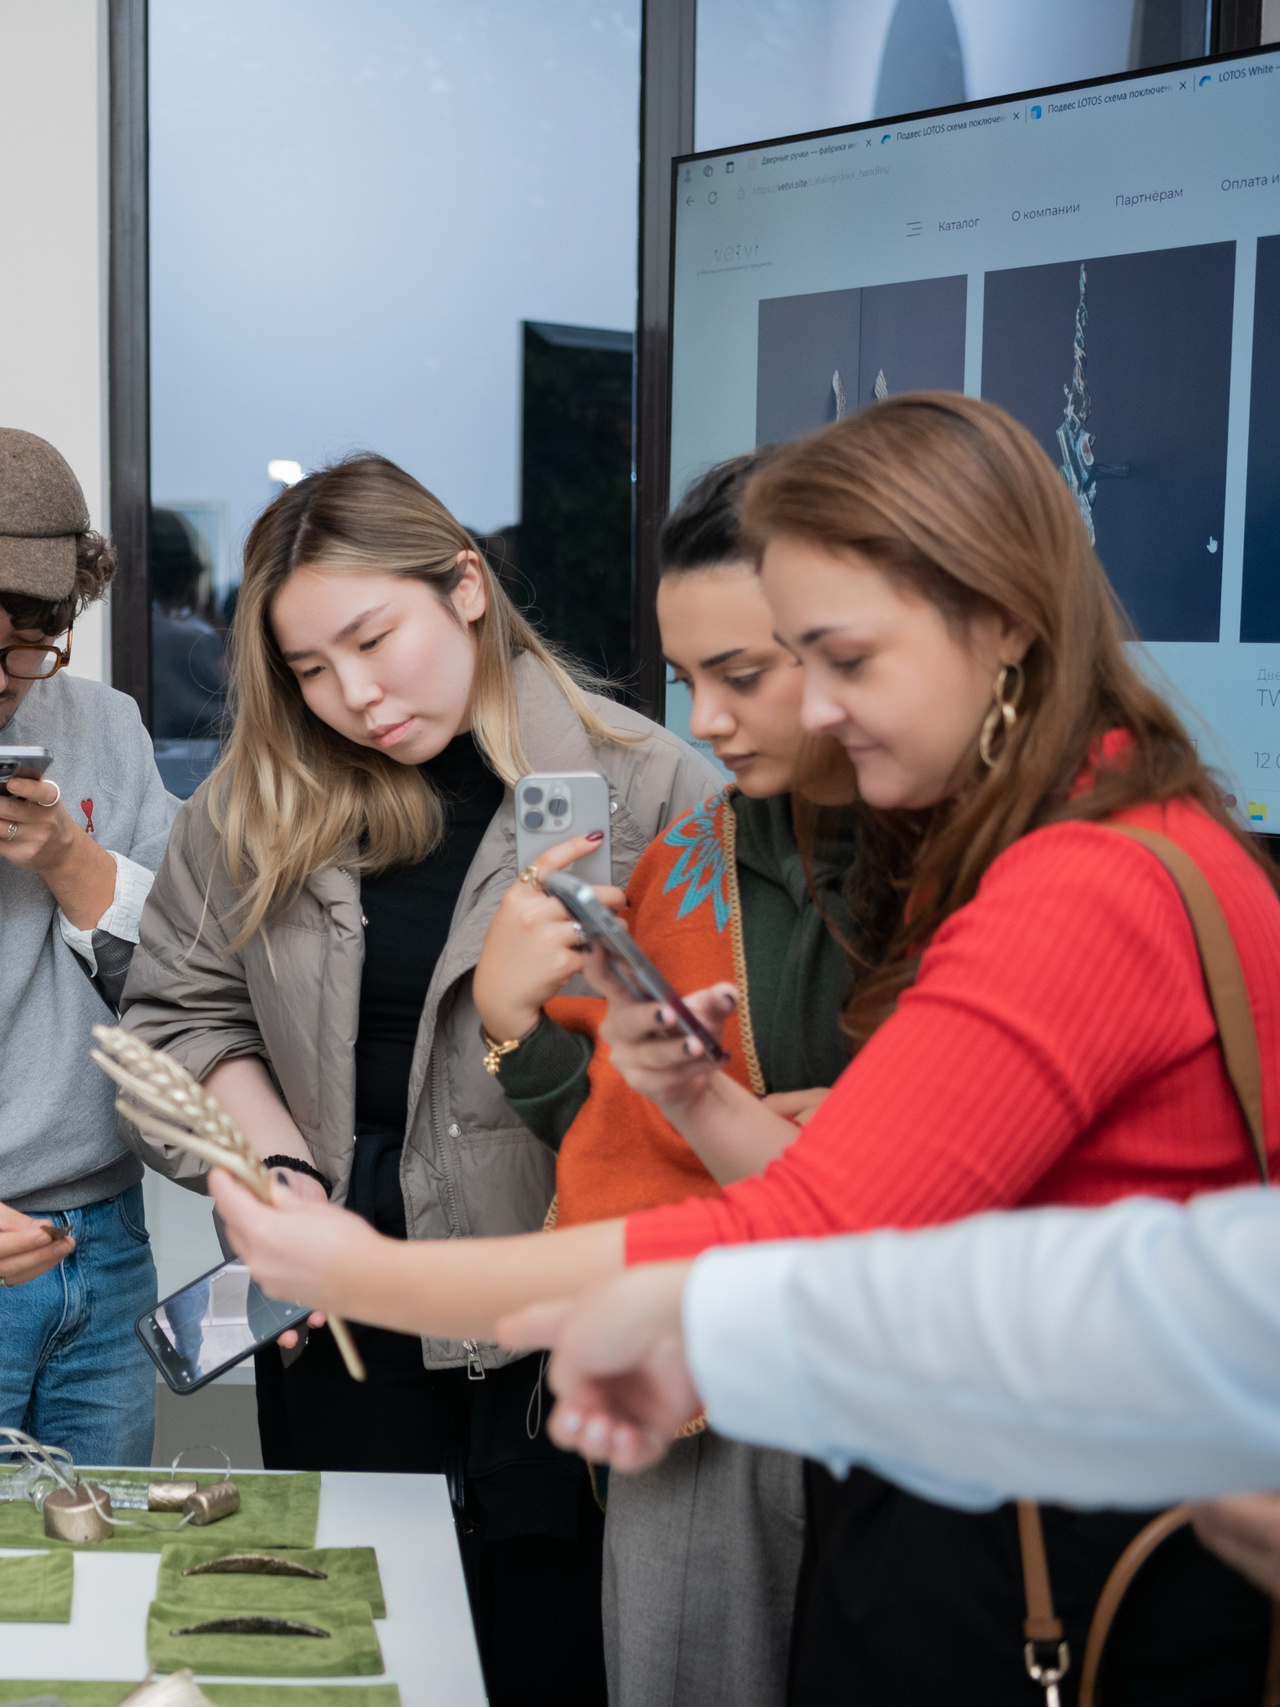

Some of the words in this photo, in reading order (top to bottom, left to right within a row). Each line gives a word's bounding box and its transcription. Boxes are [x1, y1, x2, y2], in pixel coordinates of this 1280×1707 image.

[1218, 68, 1246, 83] LOTOS
[1248, 64, 1274, 77] White
[1047, 101, 1076, 114] Подвес
[1077, 95, 1102, 108] LOTOS
[1104, 92, 1128, 104] схема
[896, 129, 922, 141] Подвес
[923, 124, 946, 136] LOTOS
[946, 120, 967, 132] схема
[1221, 175, 1268, 191] Оплата
[1271, 173, 1280, 184] и
[1115, 188, 1183, 207] Партнёрам
[1011, 210, 1021, 222] О
[1023, 203, 1081, 220] компании
[938, 217, 980, 232] Каталог
[1253, 751, 1271, 769] 12
